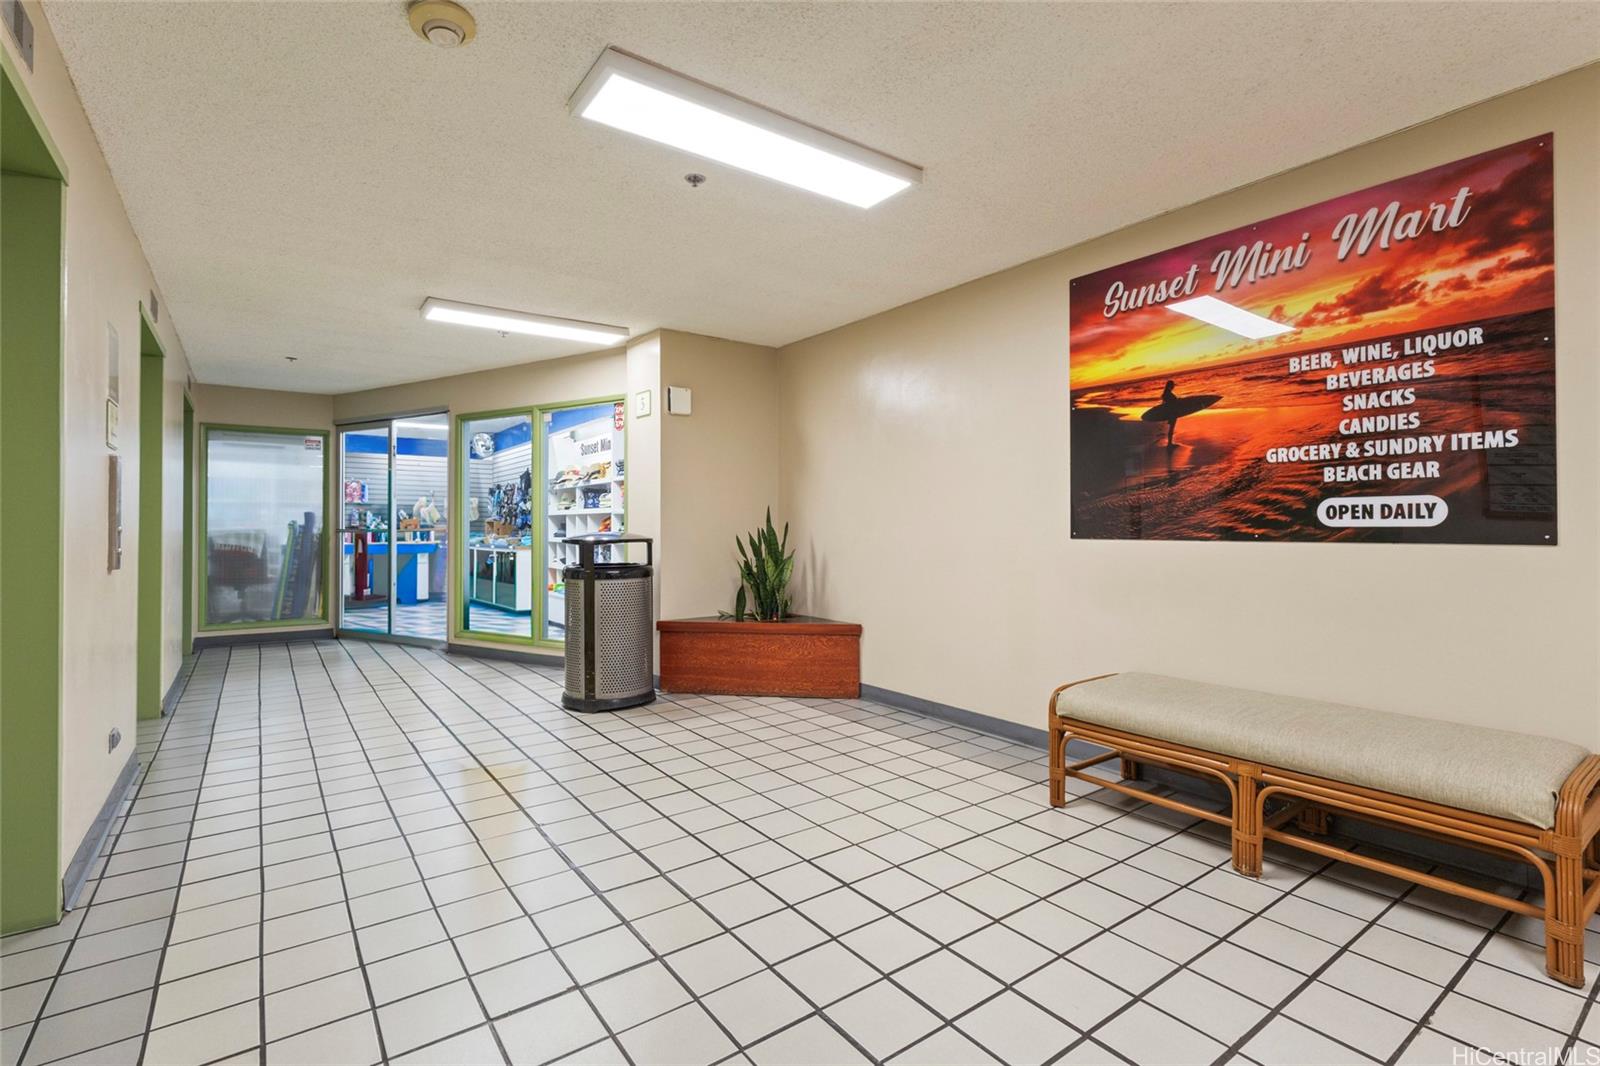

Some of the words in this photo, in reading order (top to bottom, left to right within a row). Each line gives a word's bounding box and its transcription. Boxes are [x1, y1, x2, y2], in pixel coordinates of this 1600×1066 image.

[1103, 263, 1199, 318] Sunset
[1210, 232, 1311, 291] Mini
[1331, 186, 1472, 260] Mart
[1289, 353, 1338, 373] BEER,
[1341, 346, 1399, 367] WINE,
[1404, 327, 1484, 359] LIQUOR
[1326, 359, 1436, 391] BEVERAGES
[1342, 387, 1417, 412] SNACKS
[1338, 411, 1421, 435] CANDIES
[580, 440, 599, 456] Sunset
[1266, 443, 1342, 463] GROCERY
[1346, 441, 1361, 458] &
[1363, 432, 1446, 457] SUNDRY
[1450, 428, 1519, 452] ITEMS
[1323, 462, 1382, 483] BEACH
[1386, 460, 1441, 480] GEAR
[1324, 503, 1374, 521] OPEN
[1379, 500, 1438, 520] DAILY
